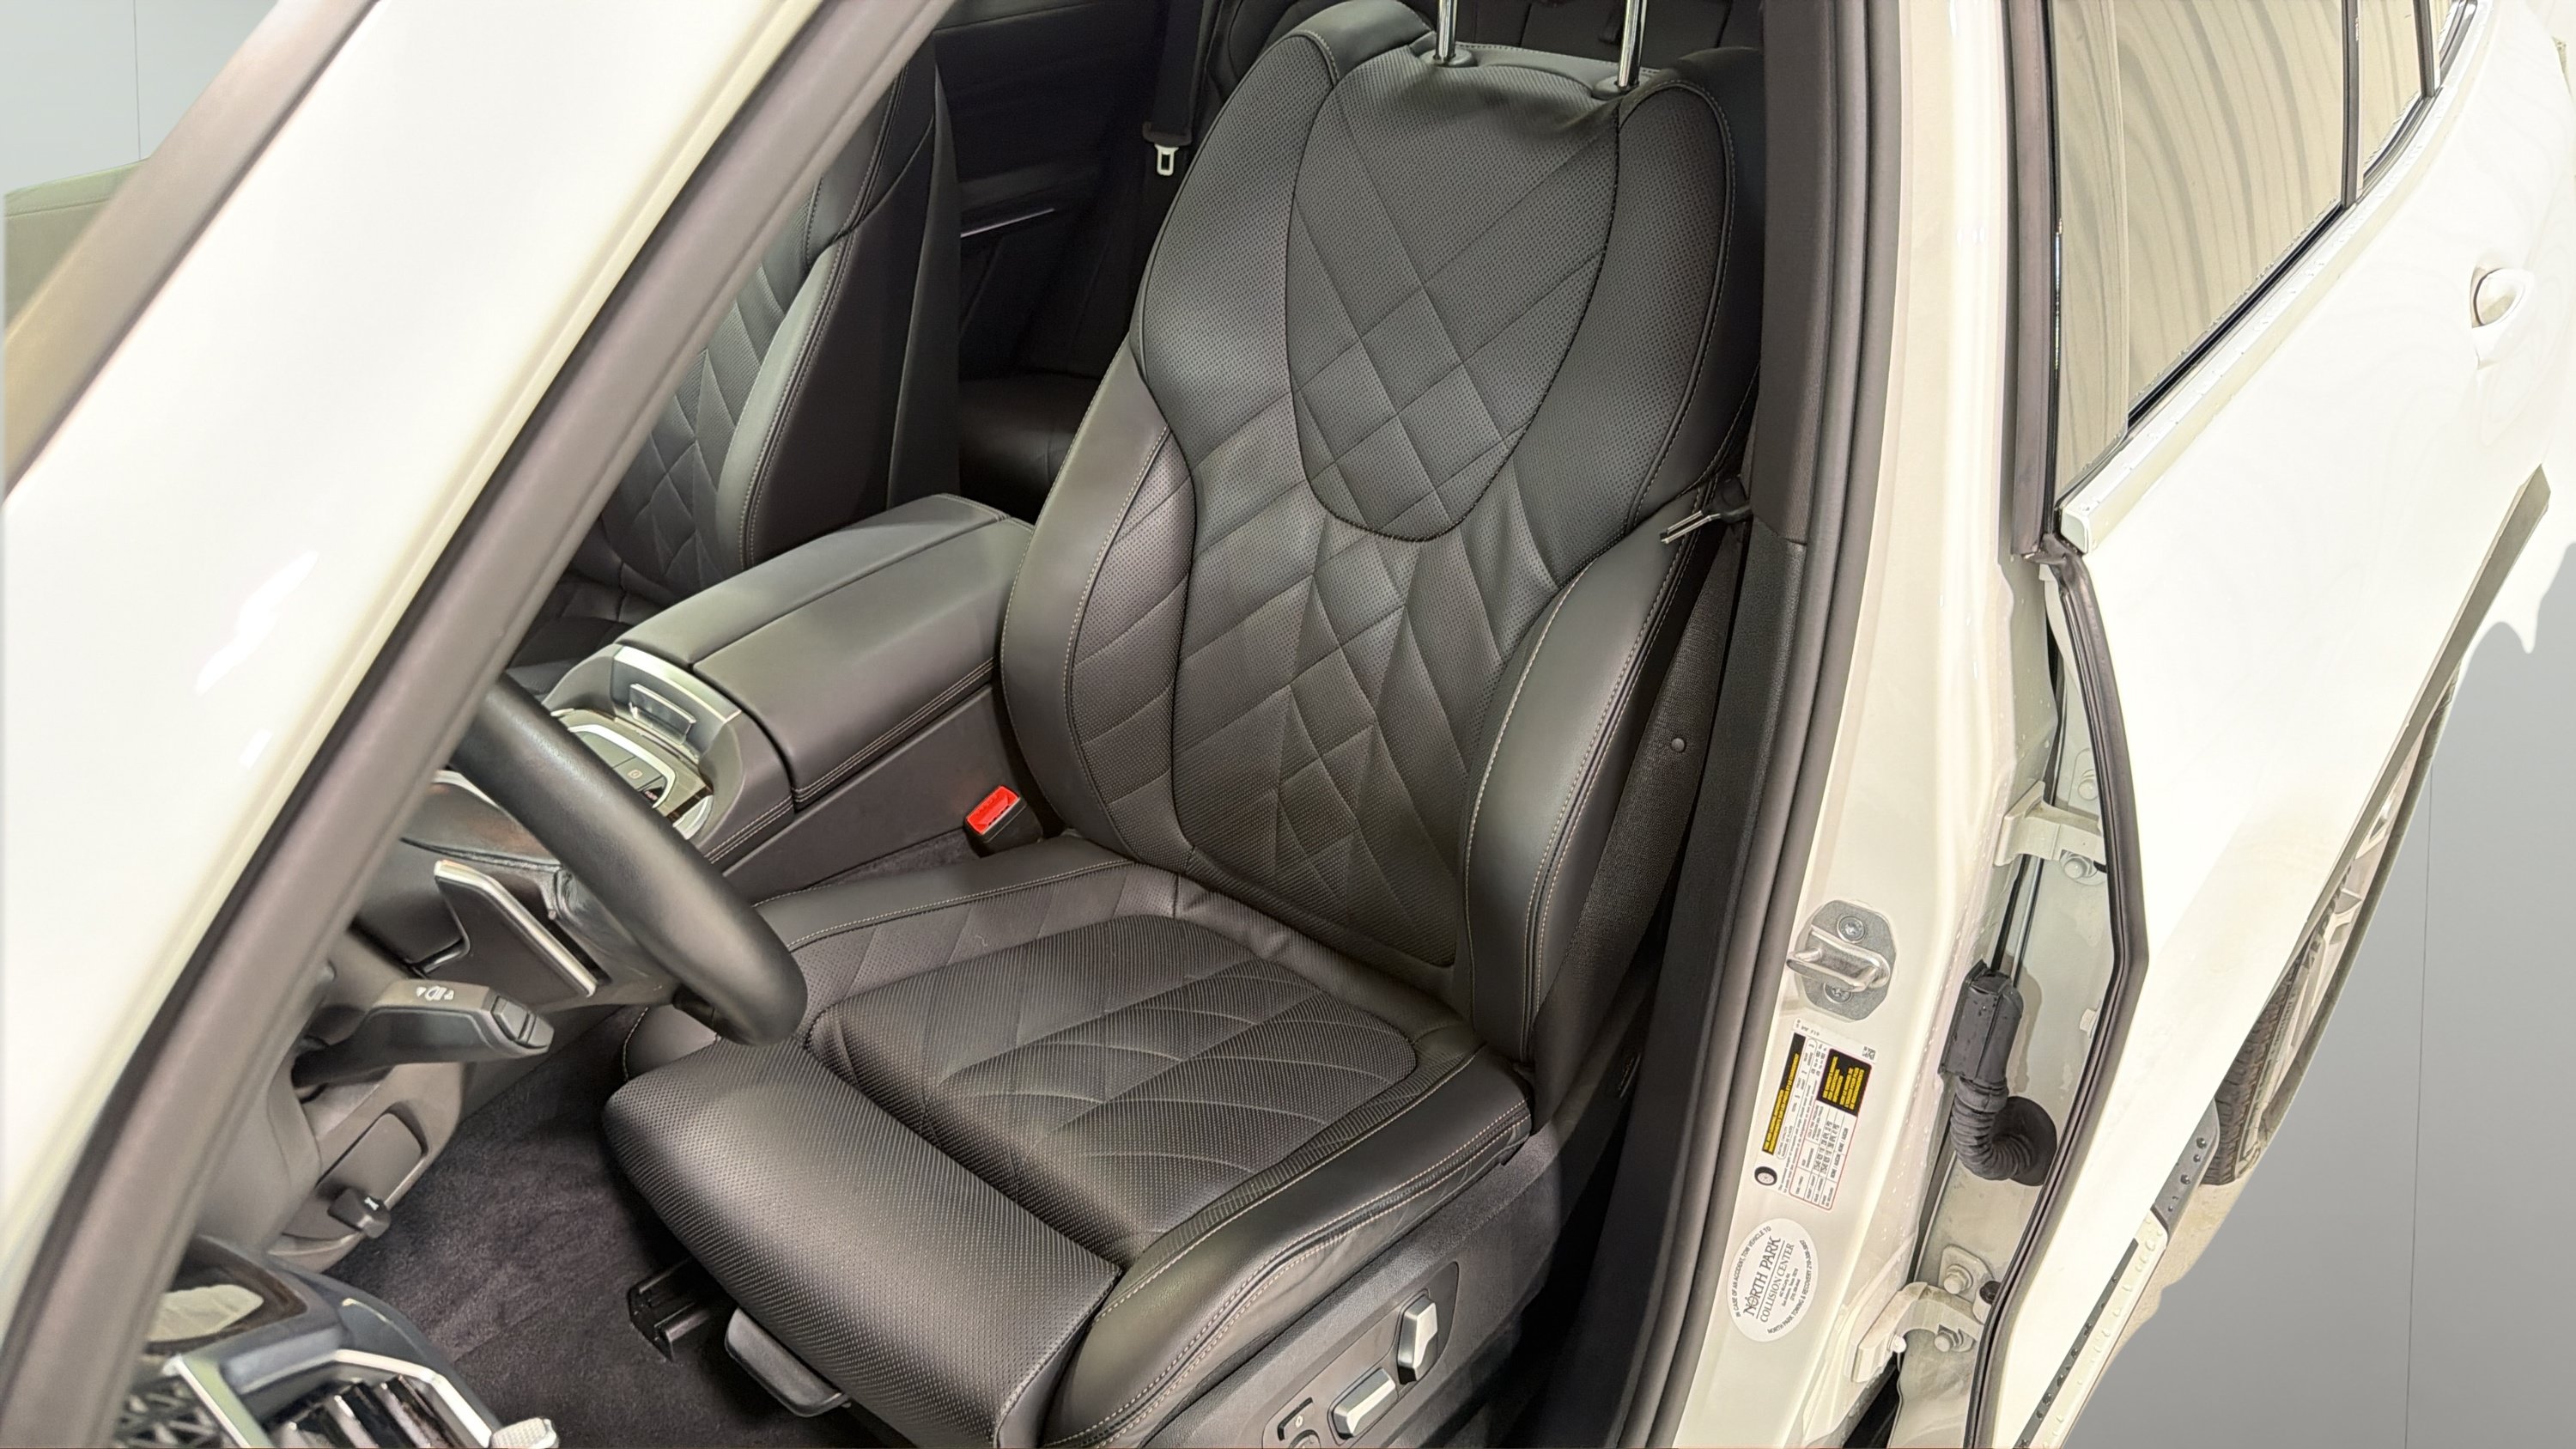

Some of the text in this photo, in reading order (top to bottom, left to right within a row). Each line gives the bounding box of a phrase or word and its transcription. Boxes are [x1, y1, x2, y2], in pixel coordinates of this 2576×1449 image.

[1734, 1257, 1746, 1282] ACCIDENT,
[1741, 1246, 1750, 1257] TOW
[1747, 1230, 1765, 1247] VEHICLE
[1743, 1235, 1781, 1317] NORTH PARK
[1759, 1243, 1795, 1323] COLLISION CENTER
[1767, 1324, 1783, 1334] NORTH
[1782, 1315, 1794, 1326] PARK
[1791, 1299, 1804, 1316] TOWING
[1801, 1269, 1812, 1295] RECOVERY
